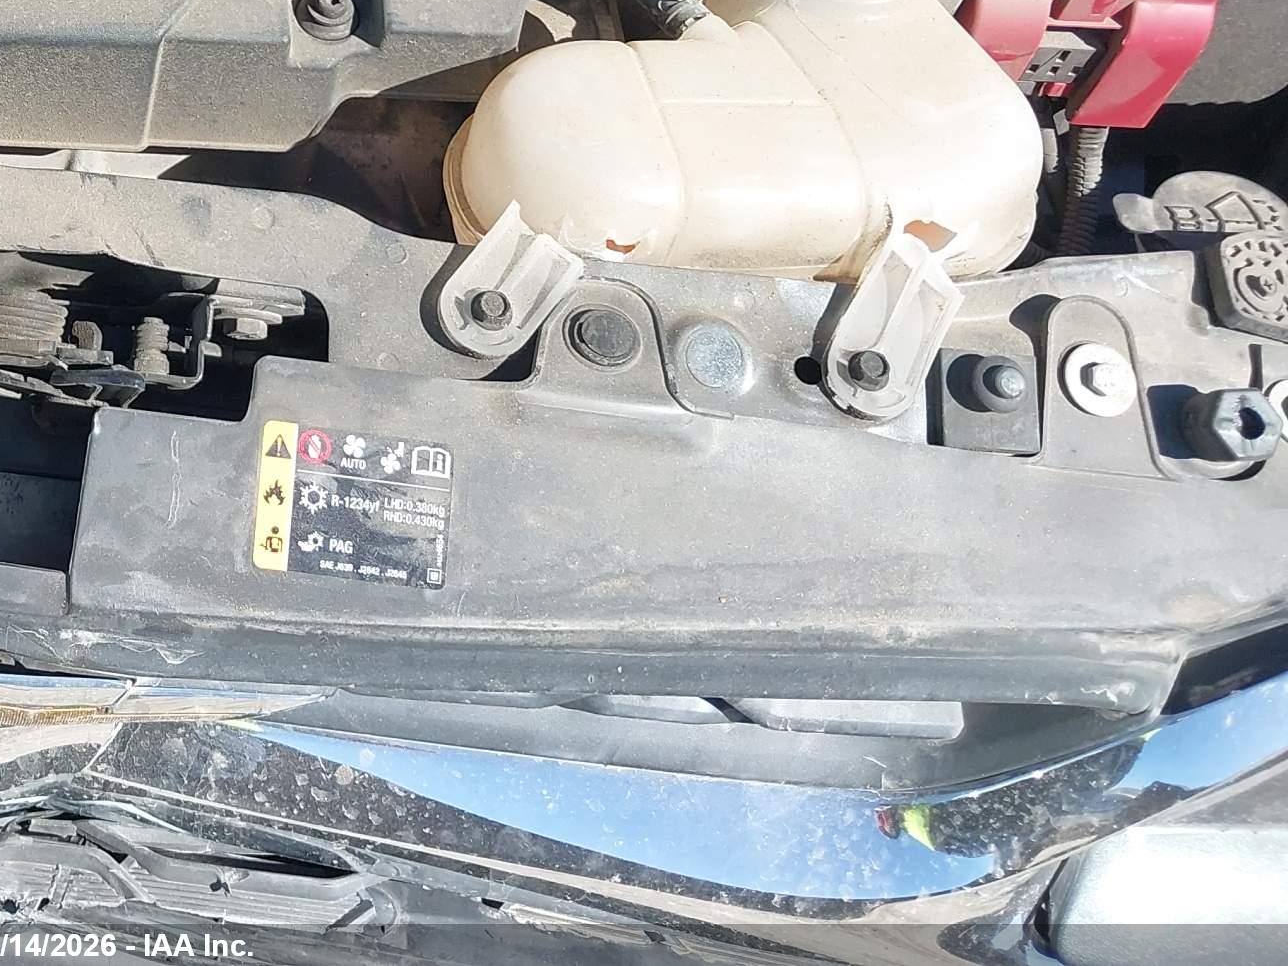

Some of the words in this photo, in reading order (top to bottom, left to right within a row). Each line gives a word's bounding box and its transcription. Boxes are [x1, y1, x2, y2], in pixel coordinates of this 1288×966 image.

[340, 457, 366, 470] AUTO
[330, 495, 380, 513] R-1234yf
[383, 510, 445, 531] RHD:0.430kg
[329, 538, 353, 554] PAG
